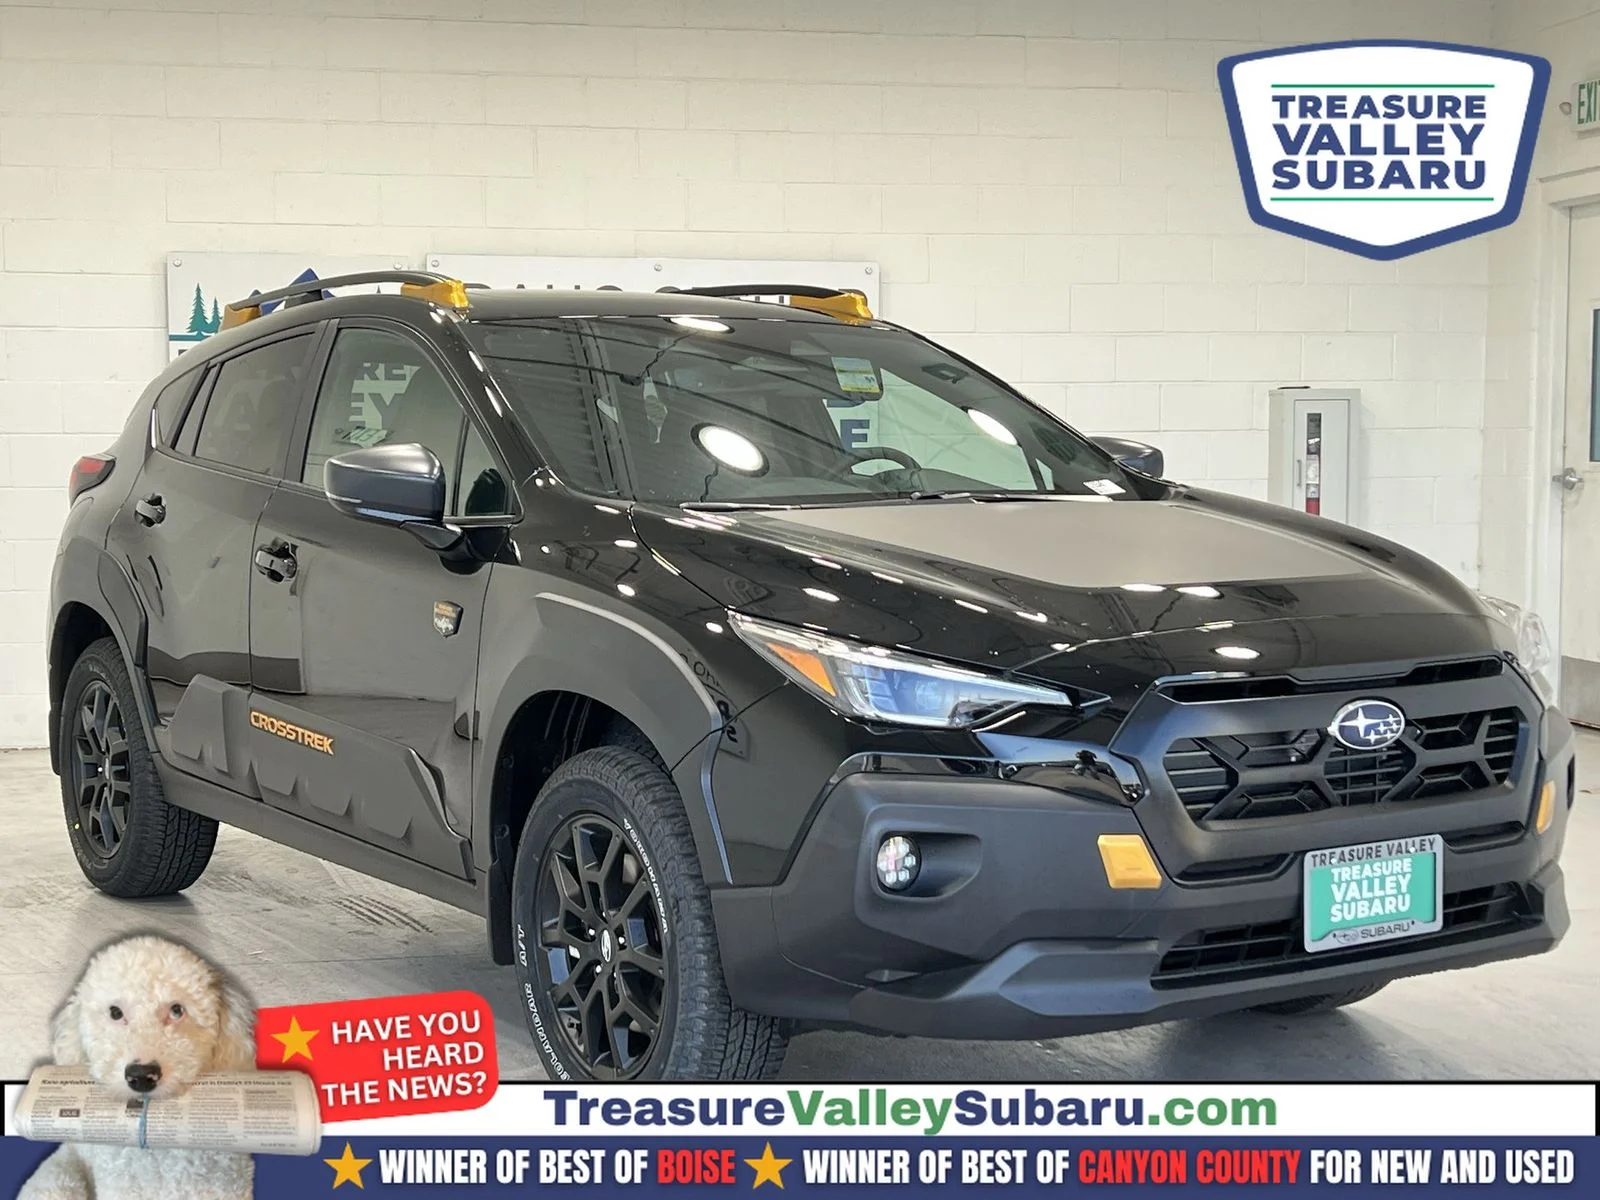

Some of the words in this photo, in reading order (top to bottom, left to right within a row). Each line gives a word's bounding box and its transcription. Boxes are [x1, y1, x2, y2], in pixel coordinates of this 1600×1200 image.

[250, 711, 334, 755] CROSSTREK
[1311, 845, 1383, 868] TREASURE
[1386, 838, 1437, 856] VALLEY
[1331, 858, 1413, 883] TREASURE
[1331, 874, 1412, 903] VALLEY
[1330, 894, 1411, 923] SUBARU
[1361, 922, 1411, 939] SUBARU
